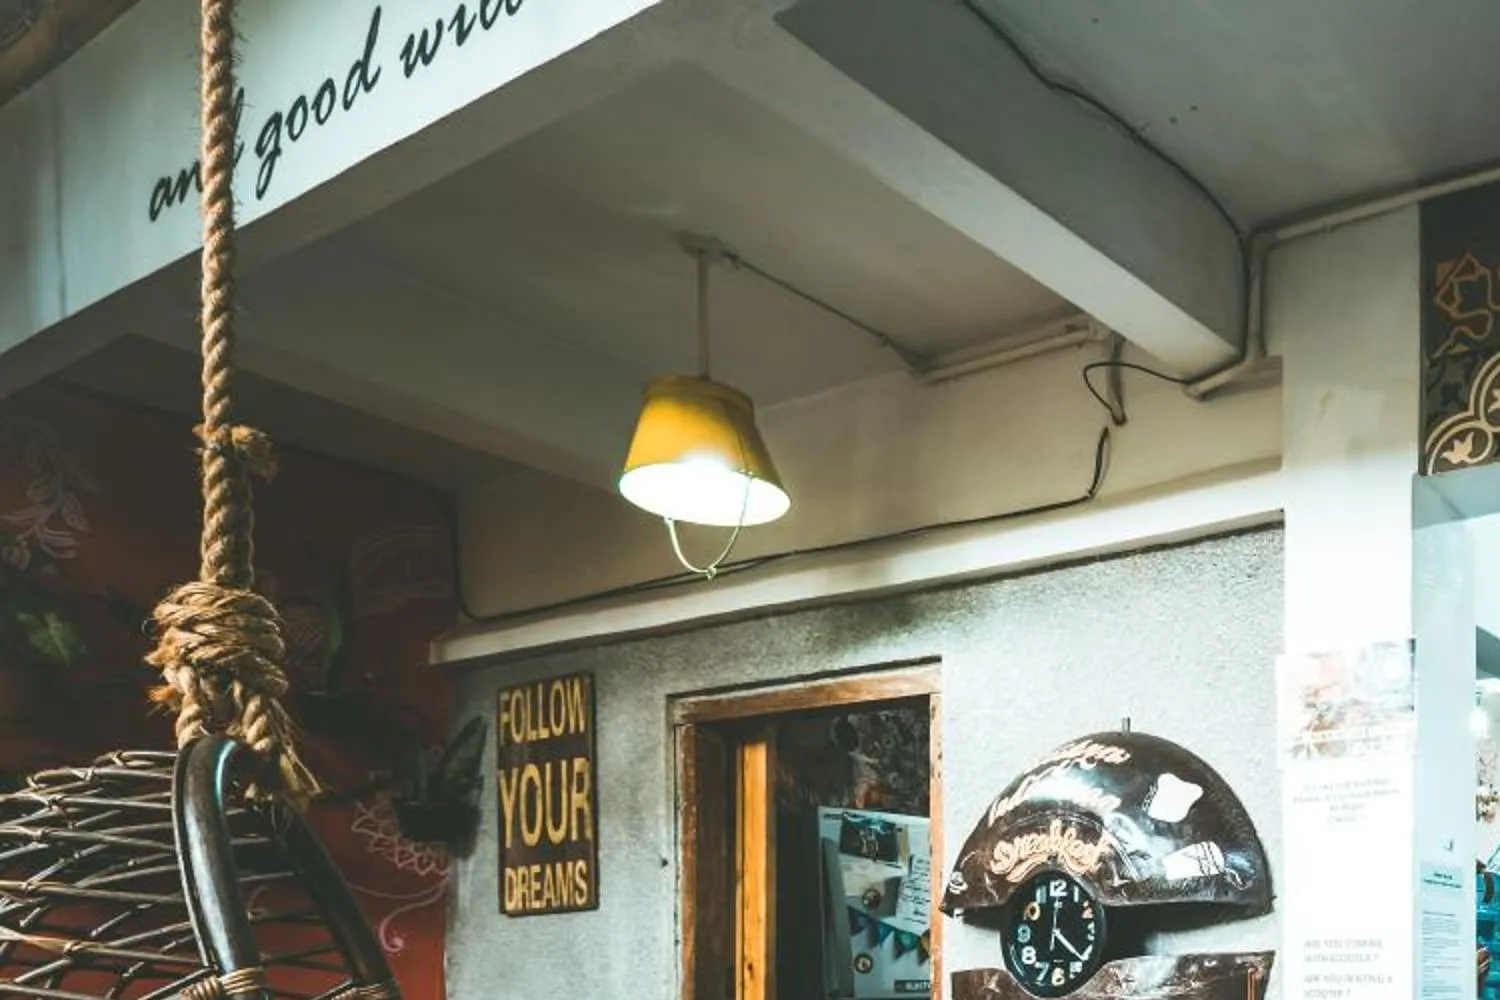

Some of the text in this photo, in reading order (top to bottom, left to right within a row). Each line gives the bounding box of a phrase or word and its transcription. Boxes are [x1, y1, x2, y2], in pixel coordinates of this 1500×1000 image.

[255, 5, 383, 200] good
[399, 0, 523, 78] wi
[500, 677, 585, 744] FOLLOW
[499, 757, 594, 849] YOUR
[505, 859, 588, 912] DREAMS
[1049, 879, 1068, 897] 12
[1073, 885, 1080, 903] 1
[1017, 923, 1031, 943] 9
[1021, 946, 1037, 965] 8
[1035, 961, 1050, 981] 7
[1051, 967, 1065, 987] 6
